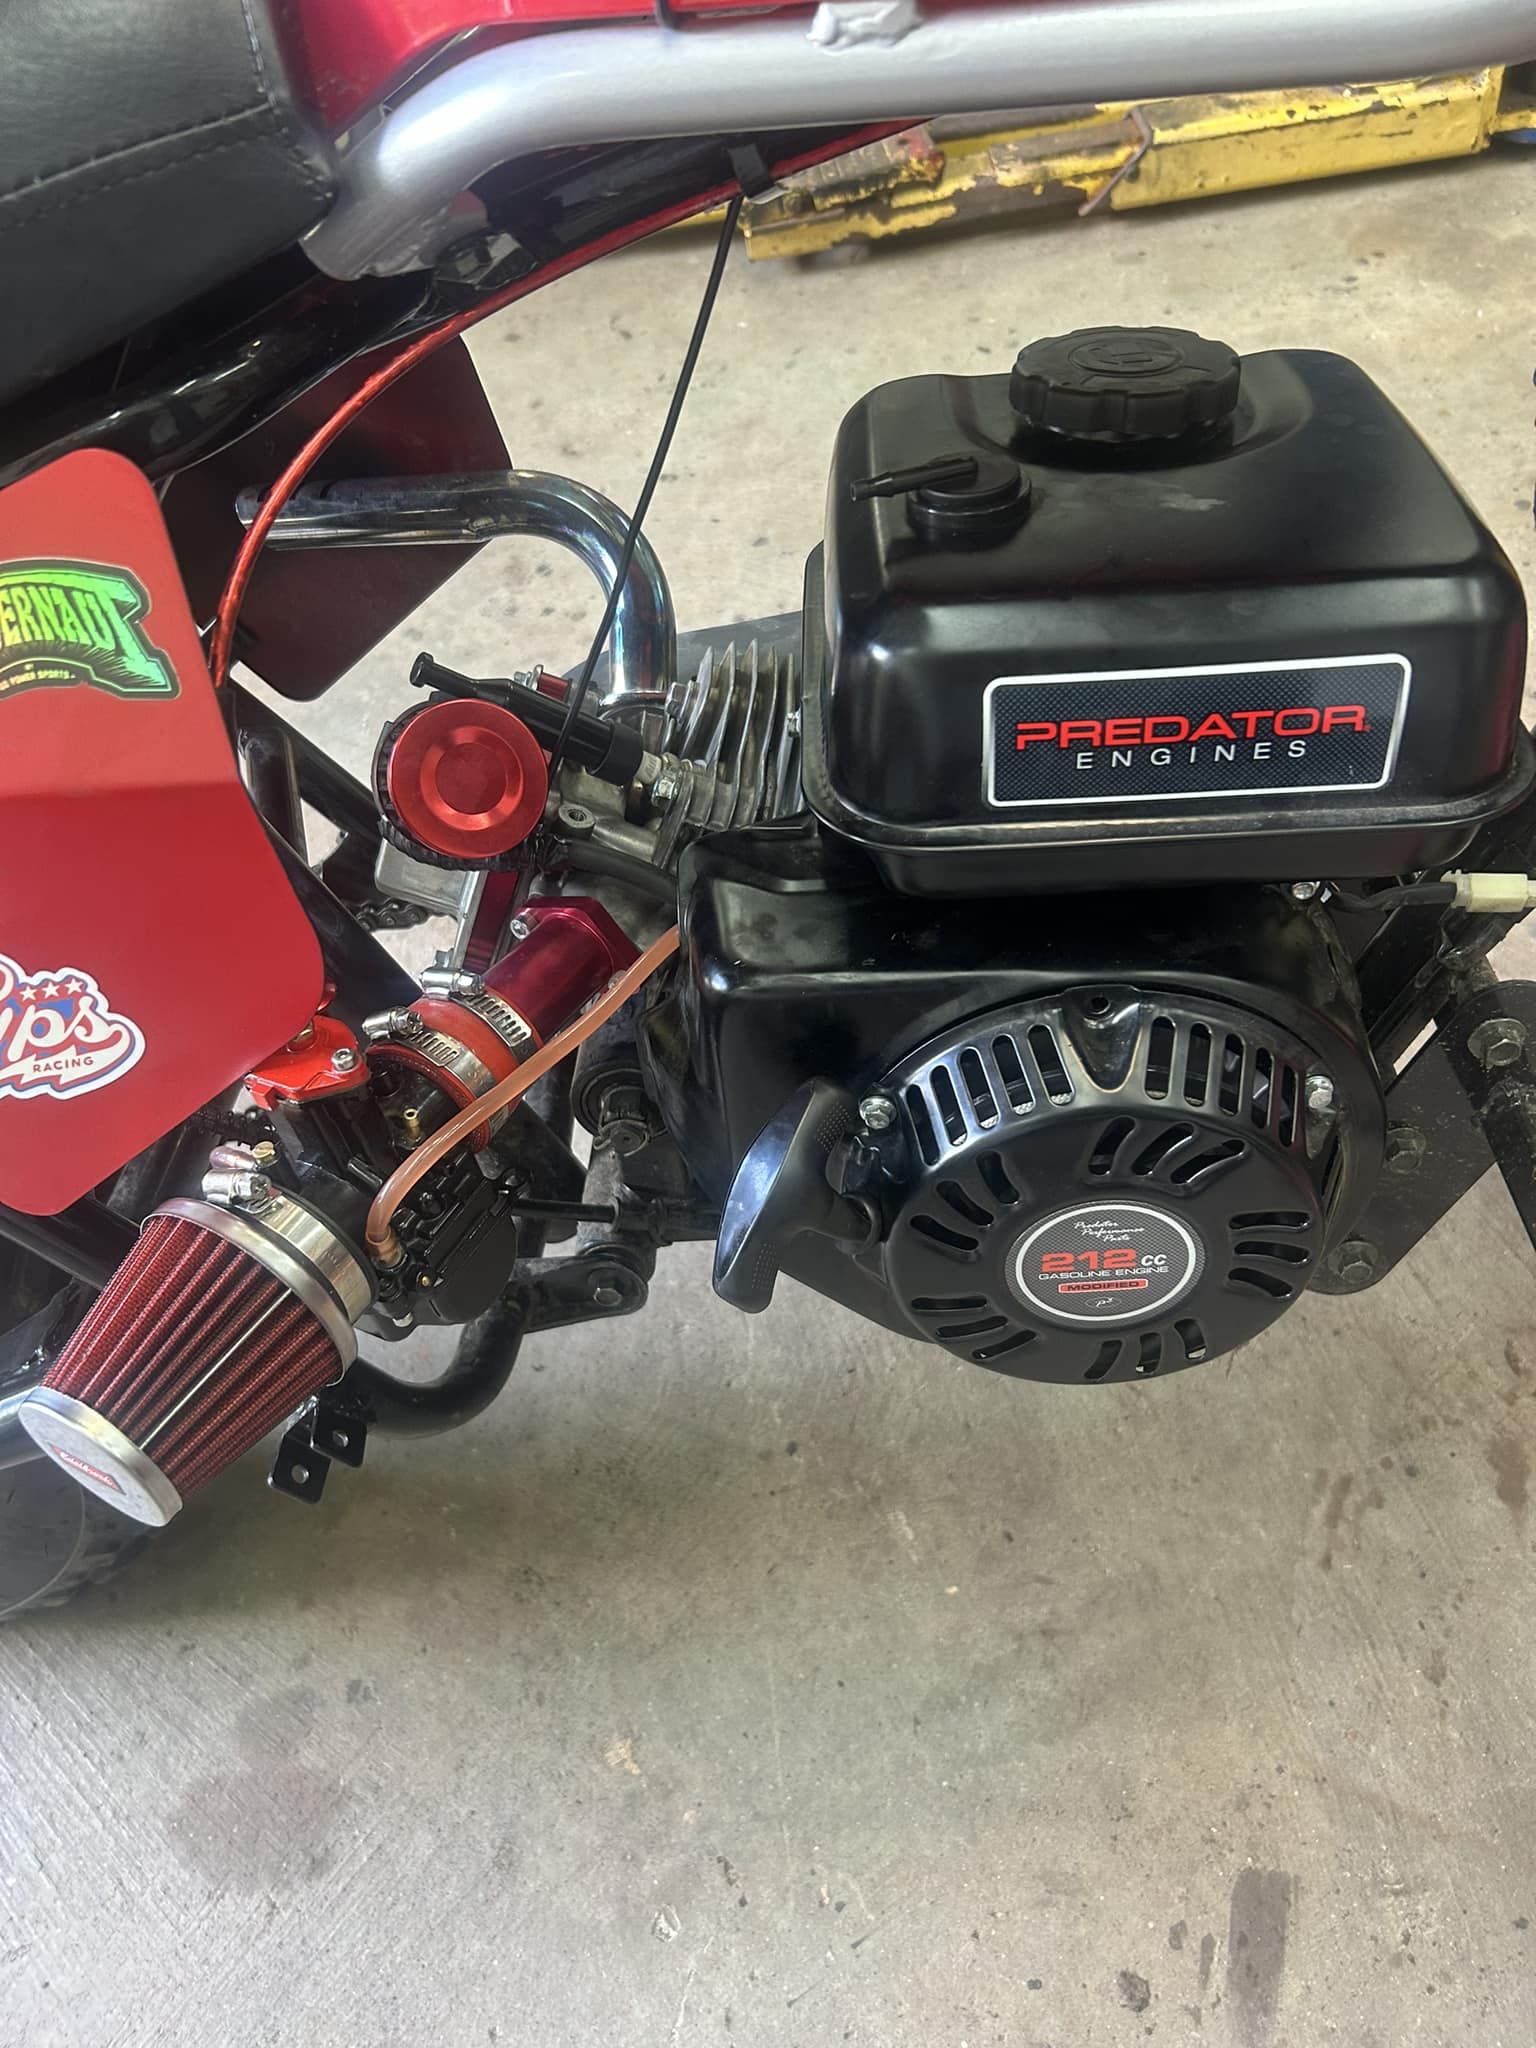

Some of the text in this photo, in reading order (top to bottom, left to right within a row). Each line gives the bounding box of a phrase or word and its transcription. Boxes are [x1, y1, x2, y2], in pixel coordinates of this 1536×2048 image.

[1016, 704, 1368, 750] PREDATOR
[1076, 740, 1308, 770] ENGINES
[32, 1056, 94, 1073] RACING
[1073, 1220, 1119, 1230] Predator
[1081, 1227, 1145, 1238] Performance
[1102, 1234, 1131, 1242] Parts
[1039, 1248, 1137, 1273] 212
[1038, 1265, 1169, 1281] GASOLINE ENGINE
[1066, 1280, 1141, 1292] MODIFIED
